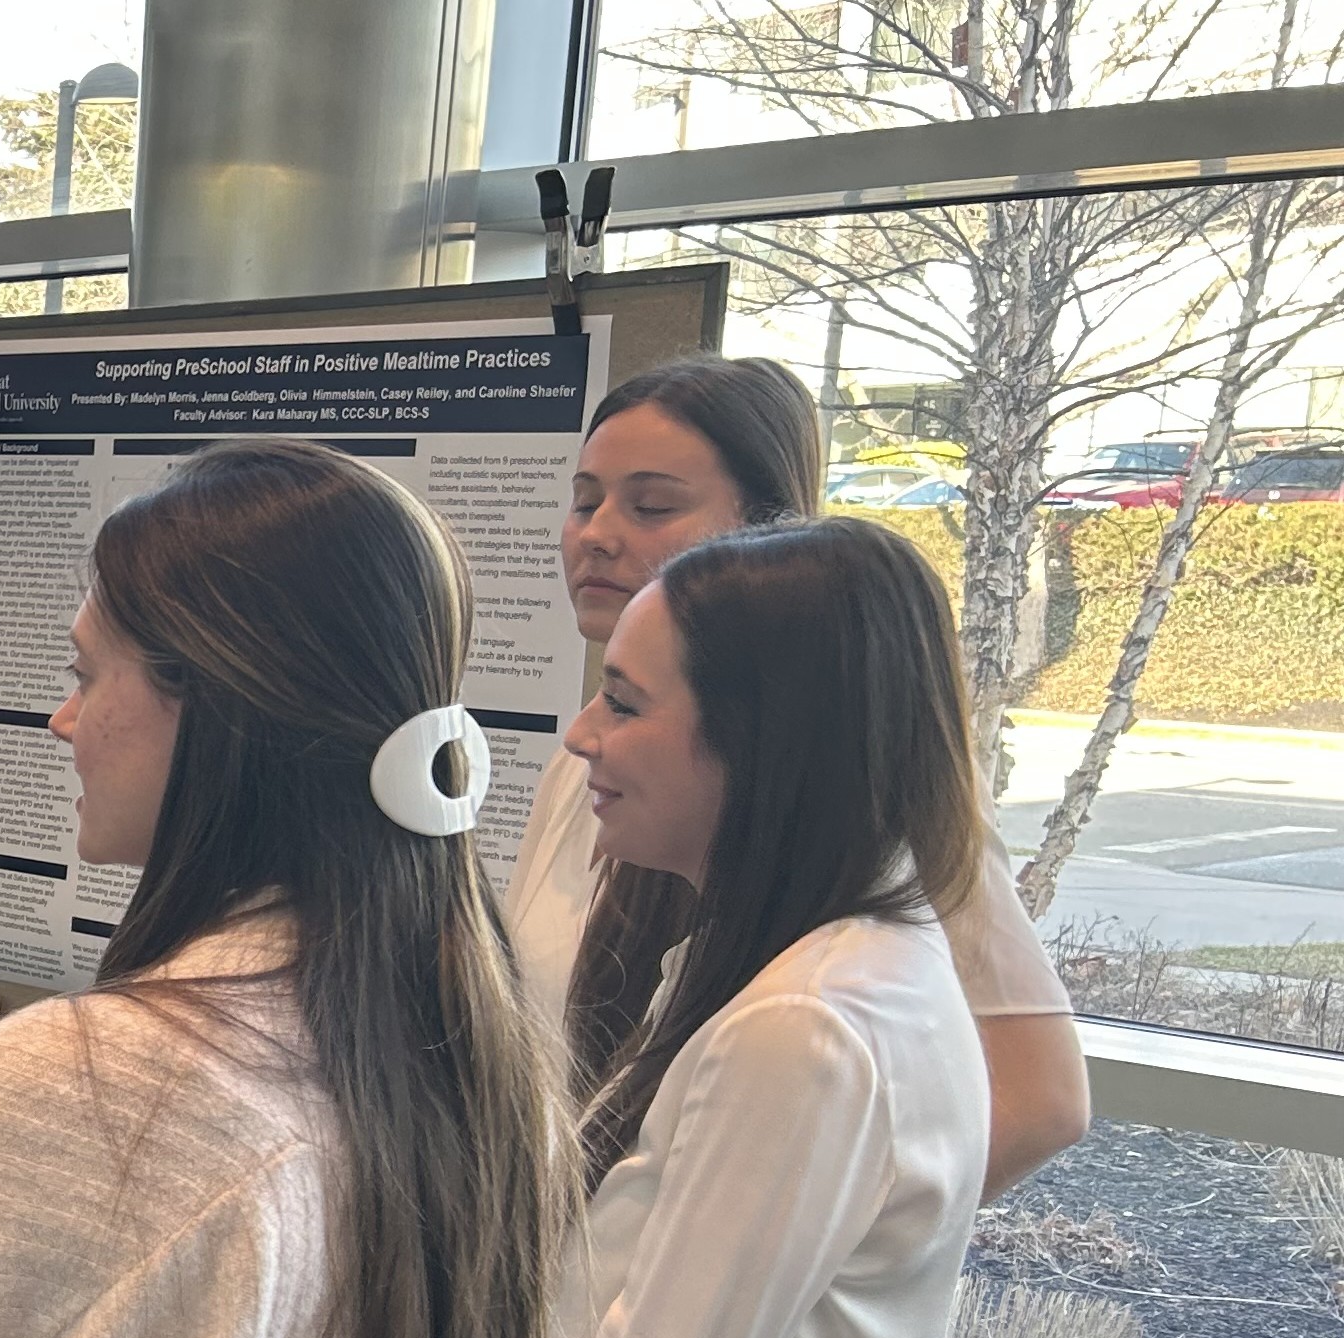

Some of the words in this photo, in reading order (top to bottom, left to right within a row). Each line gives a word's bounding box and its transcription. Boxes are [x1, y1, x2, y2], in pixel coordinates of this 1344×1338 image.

[96, 360, 171, 380] Supporting
[175, 359, 250, 375] PreSchool
[255, 355, 293, 373] Staff
[295, 355, 309, 372] in
[314, 354, 378, 371] Positive
[384, 352, 459, 370] Mealtime
[466, 350, 551, 368] Practices
[4, 393, 61, 413] University
[71, 393, 112, 403] Presented
[130, 393, 166, 405] Madelyn
[168, 392, 198, 403] Morris,
[201, 392, 229, 402] Jenna
[231, 391, 276, 403] Goldberg,
[280, 390, 307, 401] Olivia
[312, 389, 377, 401] Himmelstein,
[381, 389, 413, 402] Casey
[455, 388, 475, 399] and
[479, 387, 526, 398] Caroline
[174, 410, 206, 422] Faculty
[209, 410, 247, 420] Advisor:
[252, 410, 274, 419] Kara
[395, 407, 429, 418] BCS-S
